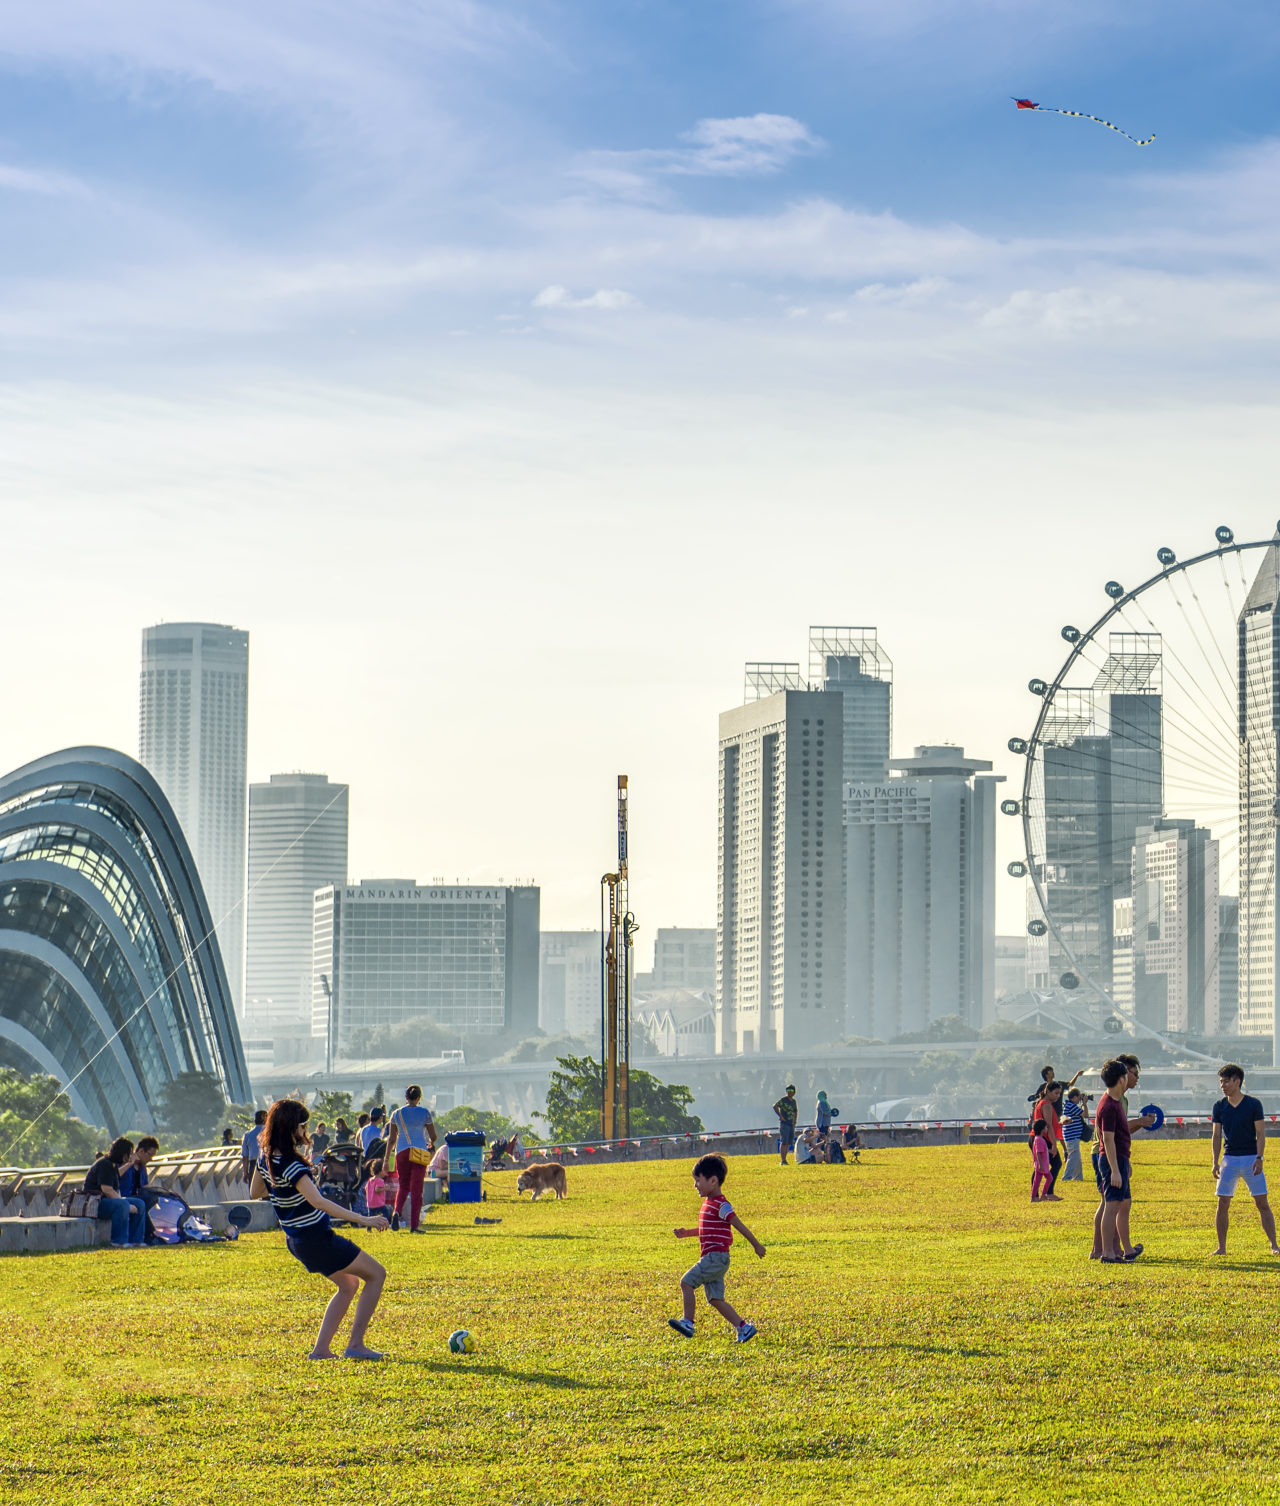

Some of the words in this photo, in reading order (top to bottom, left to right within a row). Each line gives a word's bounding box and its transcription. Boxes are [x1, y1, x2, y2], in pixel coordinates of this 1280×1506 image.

[874, 787, 917, 798] PACIFIC
[346, 889, 422, 898] MANDARIN
[430, 889, 500, 898] ORIENTAL
